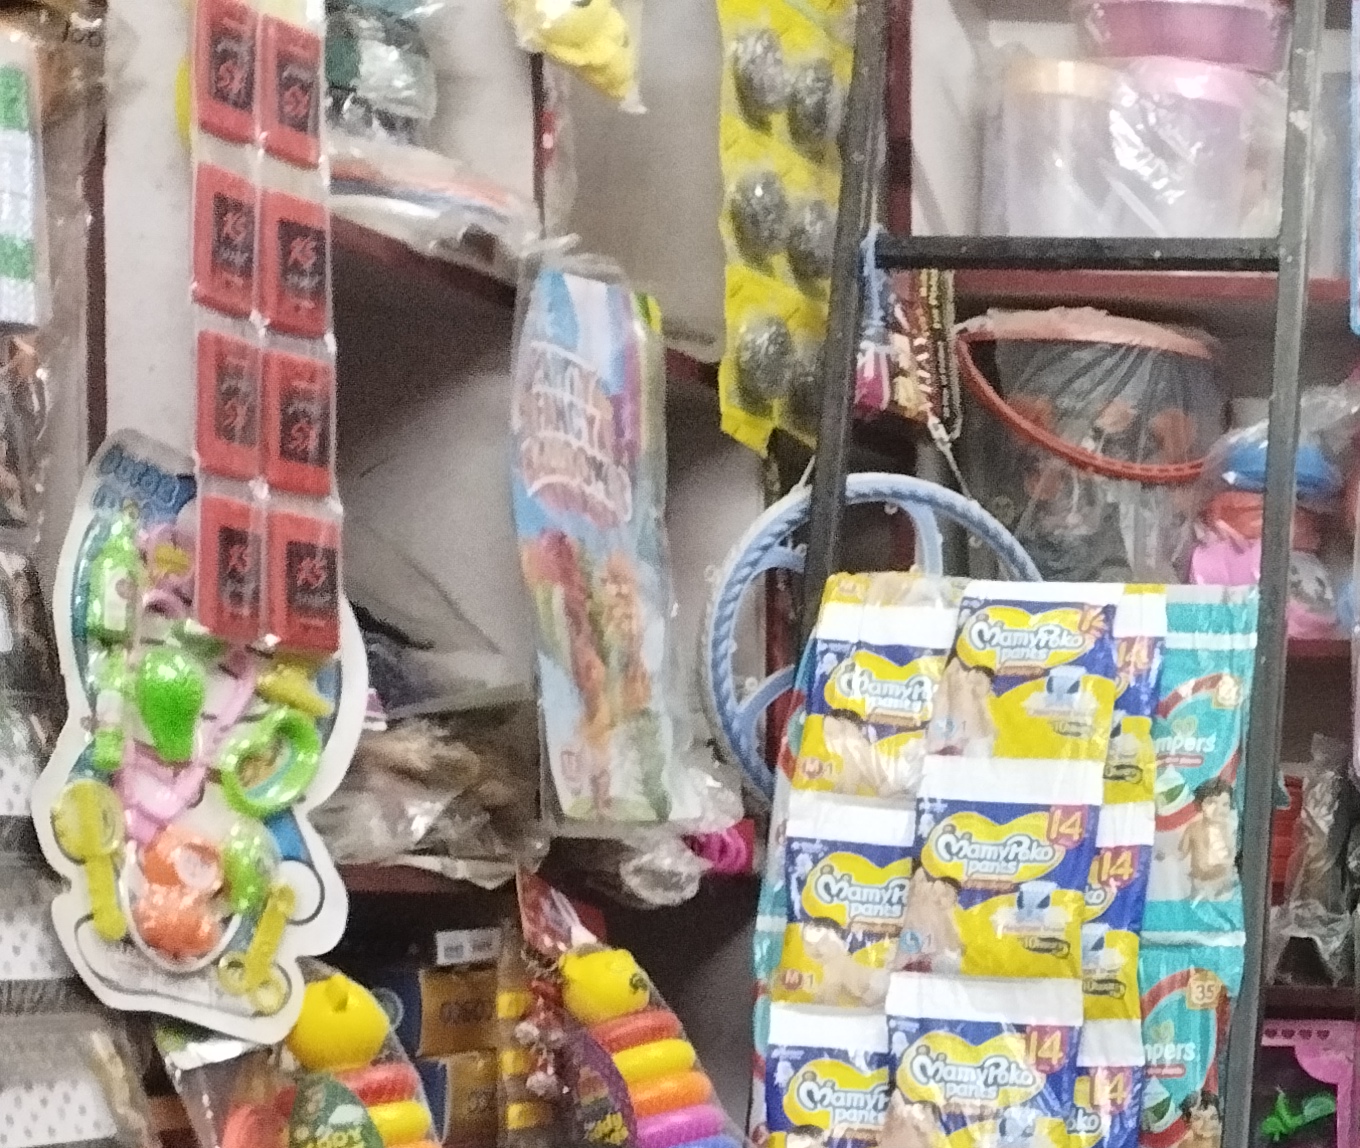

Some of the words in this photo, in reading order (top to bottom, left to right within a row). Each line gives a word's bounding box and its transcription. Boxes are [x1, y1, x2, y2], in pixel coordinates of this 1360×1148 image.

[969, 618, 1084, 653] MamyPoko
[994, 648, 1049, 665] pants
[836, 668, 936, 702] MamyP
[1155, 729, 1215, 755] mpers
[1048, 810, 1083, 842] 14
[935, 835, 1055, 865] MamyPoko
[965, 859, 1020, 876] pants
[1102, 850, 1134, 881] 14
[815, 874, 911, 905] MamyP
[1193, 982, 1218, 1000] 35
[1028, 1029, 1065, 1065] 14
[911, 1054, 1036, 1089] MamyPoko
[797, 1082, 890, 1112] MamyP
[943, 1082, 999, 1100] pants
